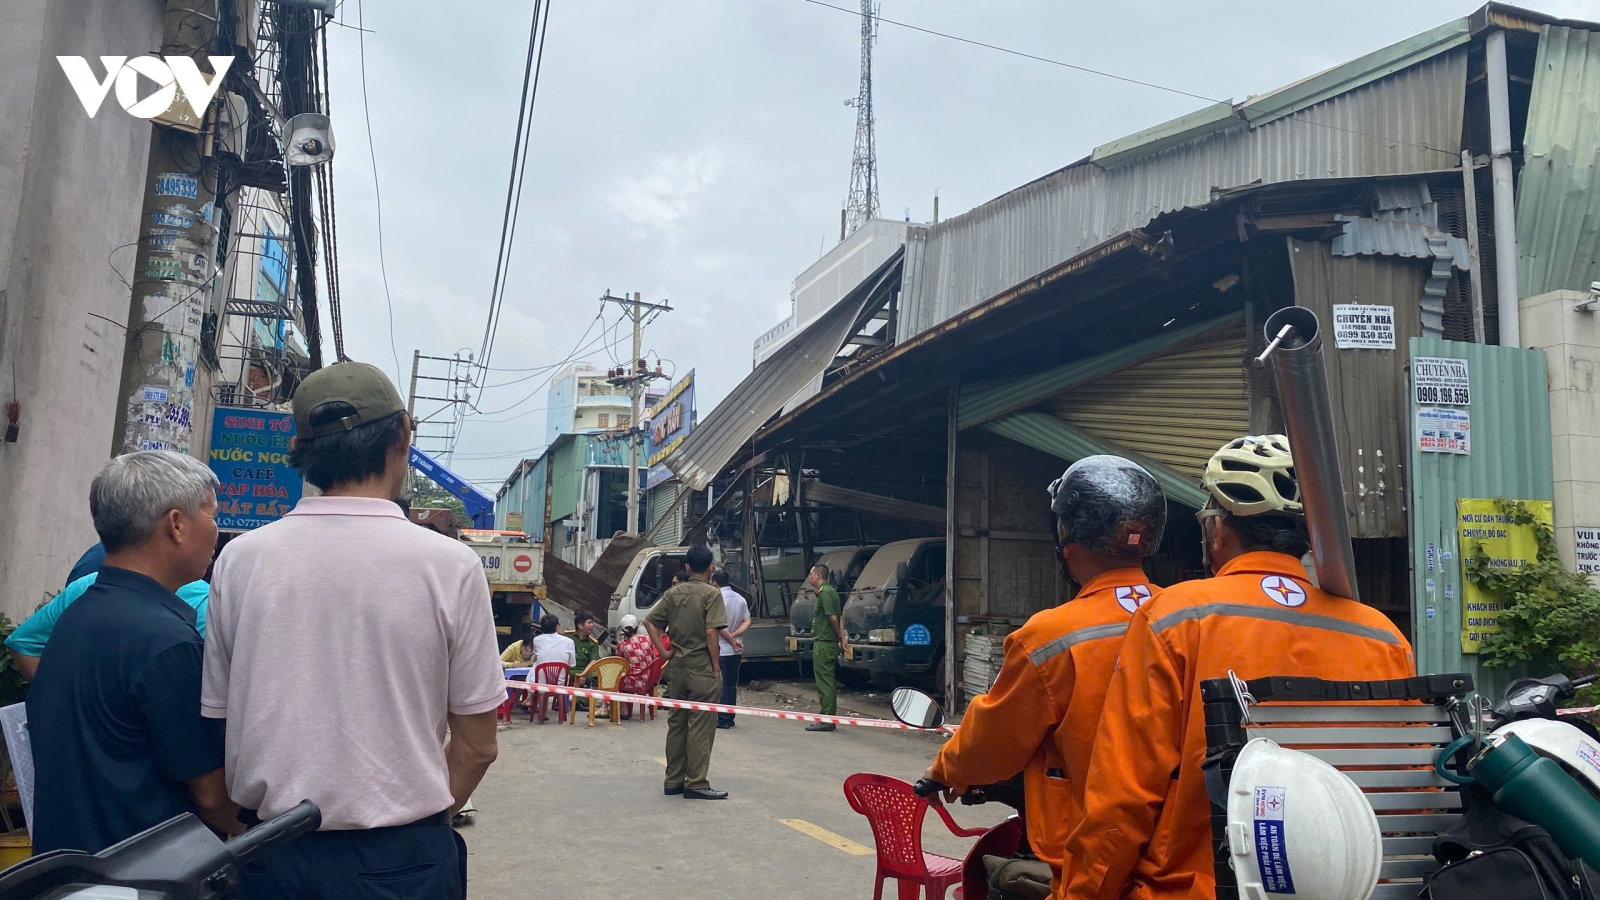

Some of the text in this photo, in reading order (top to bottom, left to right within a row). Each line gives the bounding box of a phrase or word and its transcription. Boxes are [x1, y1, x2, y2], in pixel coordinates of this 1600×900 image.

[1336, 311, 1392, 324] CHUYỂN NHÀ
[1451, 362, 1467, 378] NHÀ
[1417, 387, 1469, 403] 0909.196.559
[225, 415, 292, 432] SINH TỐ
[221, 431, 267, 446] NƯỚC
[210, 448, 253, 462] NƯỚC
[217, 482, 288, 498] TẠP HÓA
[256, 499, 290, 517] SẤY
[1577, 531, 1594, 540] VUI
[1577, 541, 1599, 549] KHÔNG
[1467, 601, 1487, 611] KHÁCH
[1469, 618, 1482, 626] GIAO
[1259, 822, 1267, 835] LÀM
[1270, 825, 1278, 834] AN
[1259, 836, 1268, 850] VIỆC
[1271, 835, 1280, 851] TOÀN
[1264, 866, 1272, 875] AN
